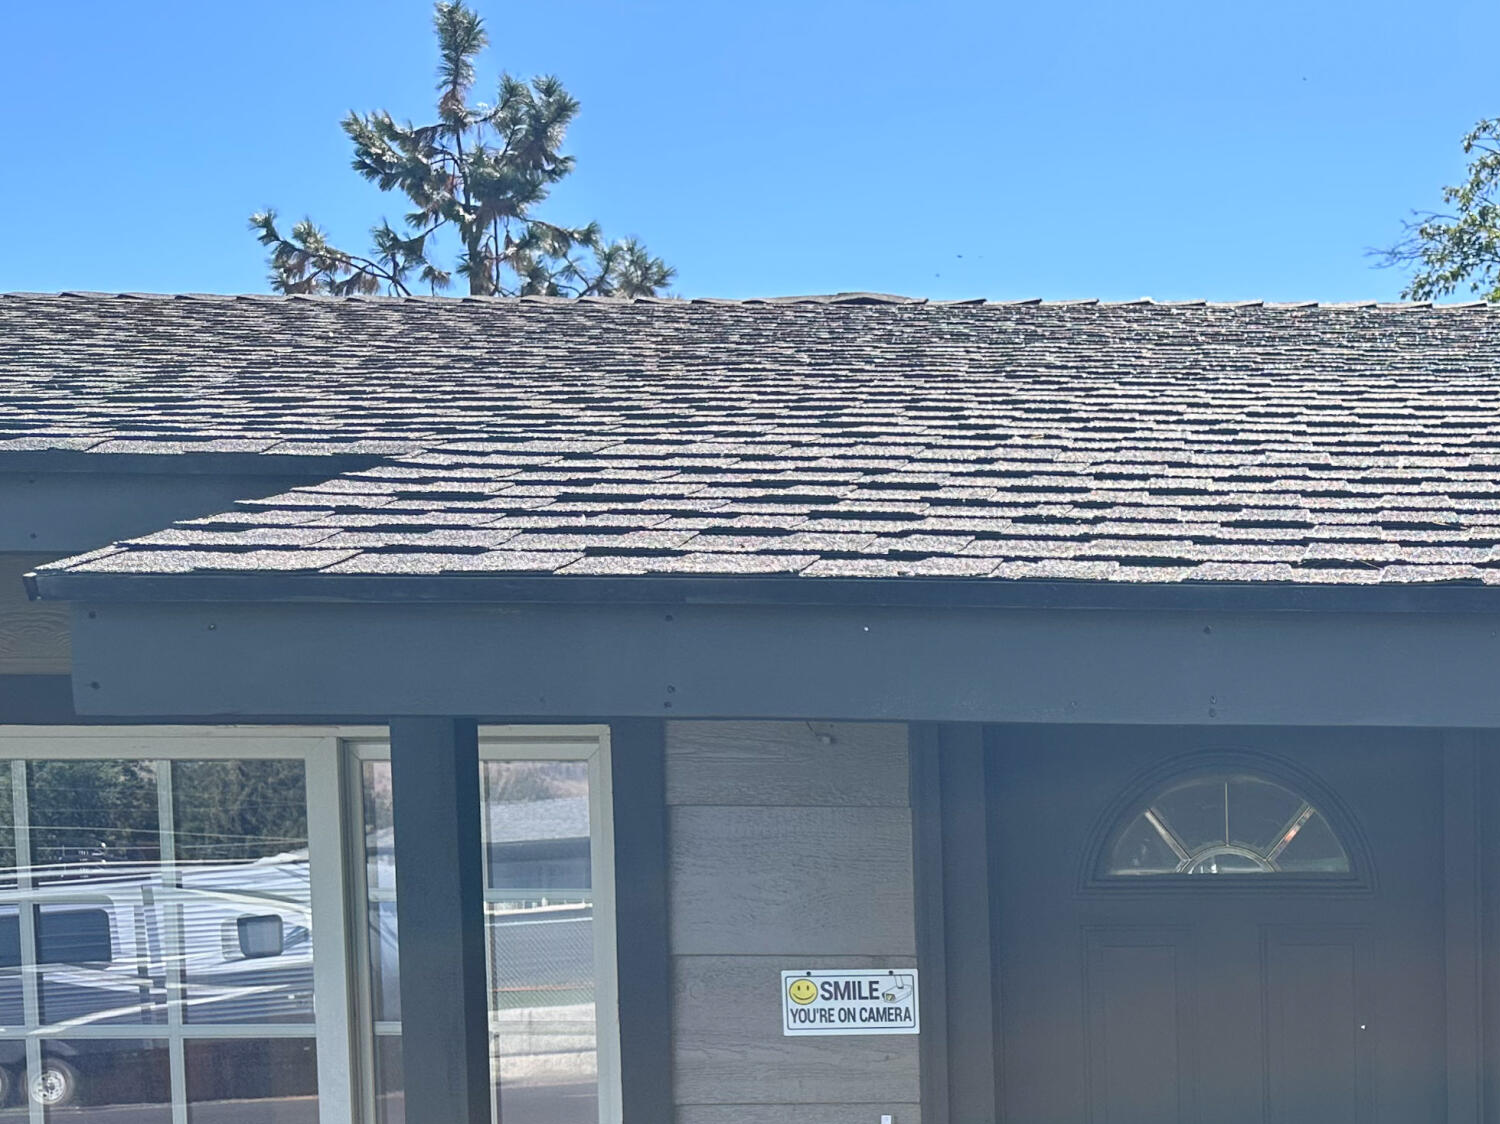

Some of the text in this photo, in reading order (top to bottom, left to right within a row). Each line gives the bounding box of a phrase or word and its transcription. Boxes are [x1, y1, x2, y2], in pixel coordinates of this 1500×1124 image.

[820, 980, 881, 1001] SMILE
[790, 1007, 912, 1024] YOU'RE ON CAMERA
